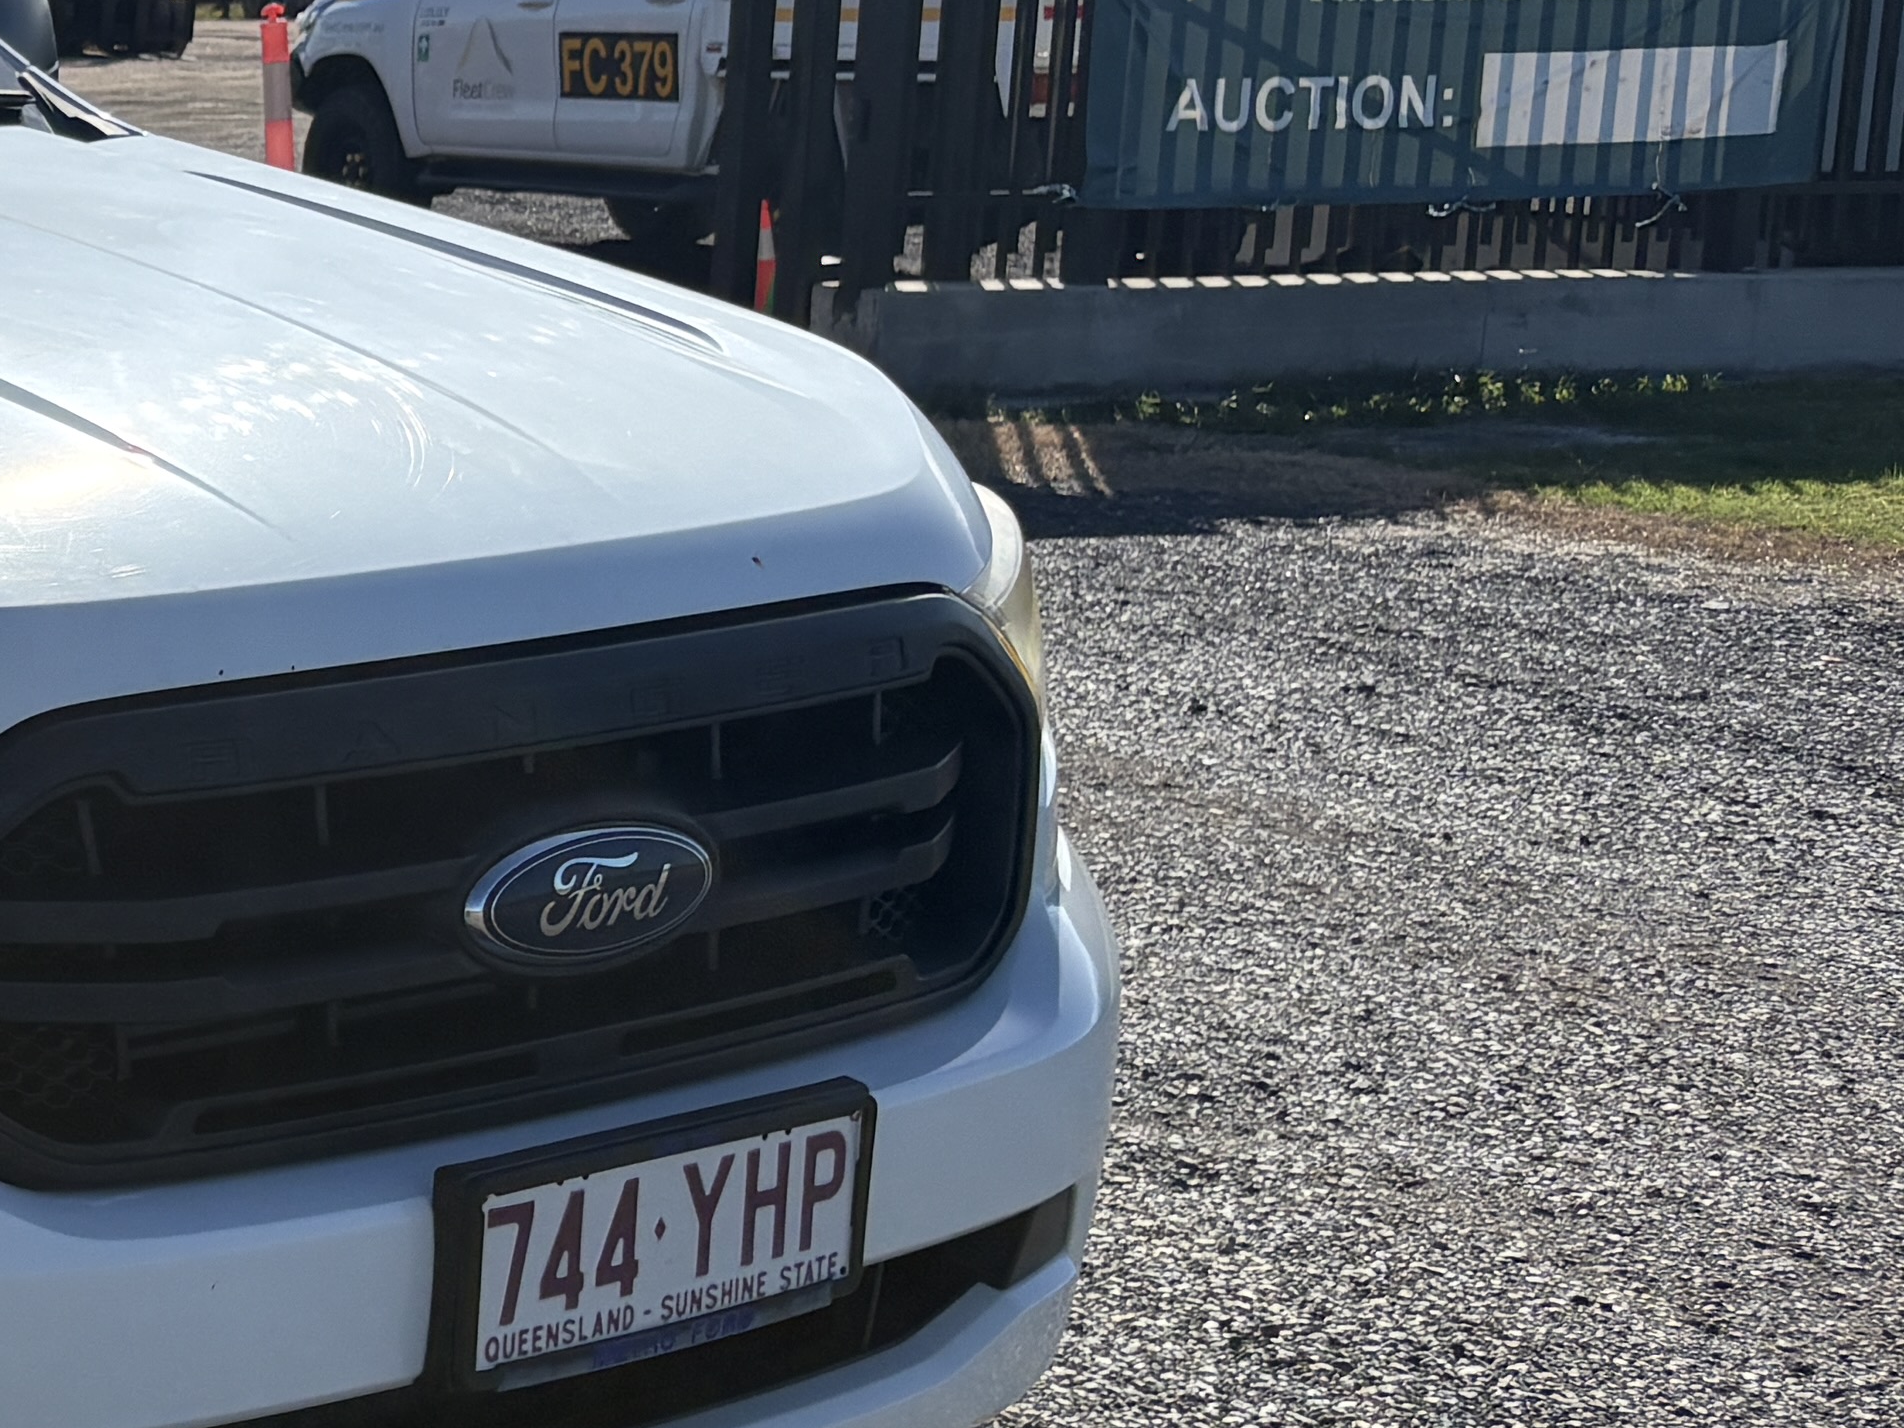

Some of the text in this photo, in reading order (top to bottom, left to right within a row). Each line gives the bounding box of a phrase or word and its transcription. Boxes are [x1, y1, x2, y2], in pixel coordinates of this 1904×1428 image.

[562, 38, 674, 98] FC 379
[1165, 74, 1454, 133] AUCTION:
[539, 851, 672, 937] Ford
[484, 1304, 635, 1364] QUEENSLAND
[660, 1269, 768, 1322] SUNSHINE
[779, 1251, 839, 1293] STATE
